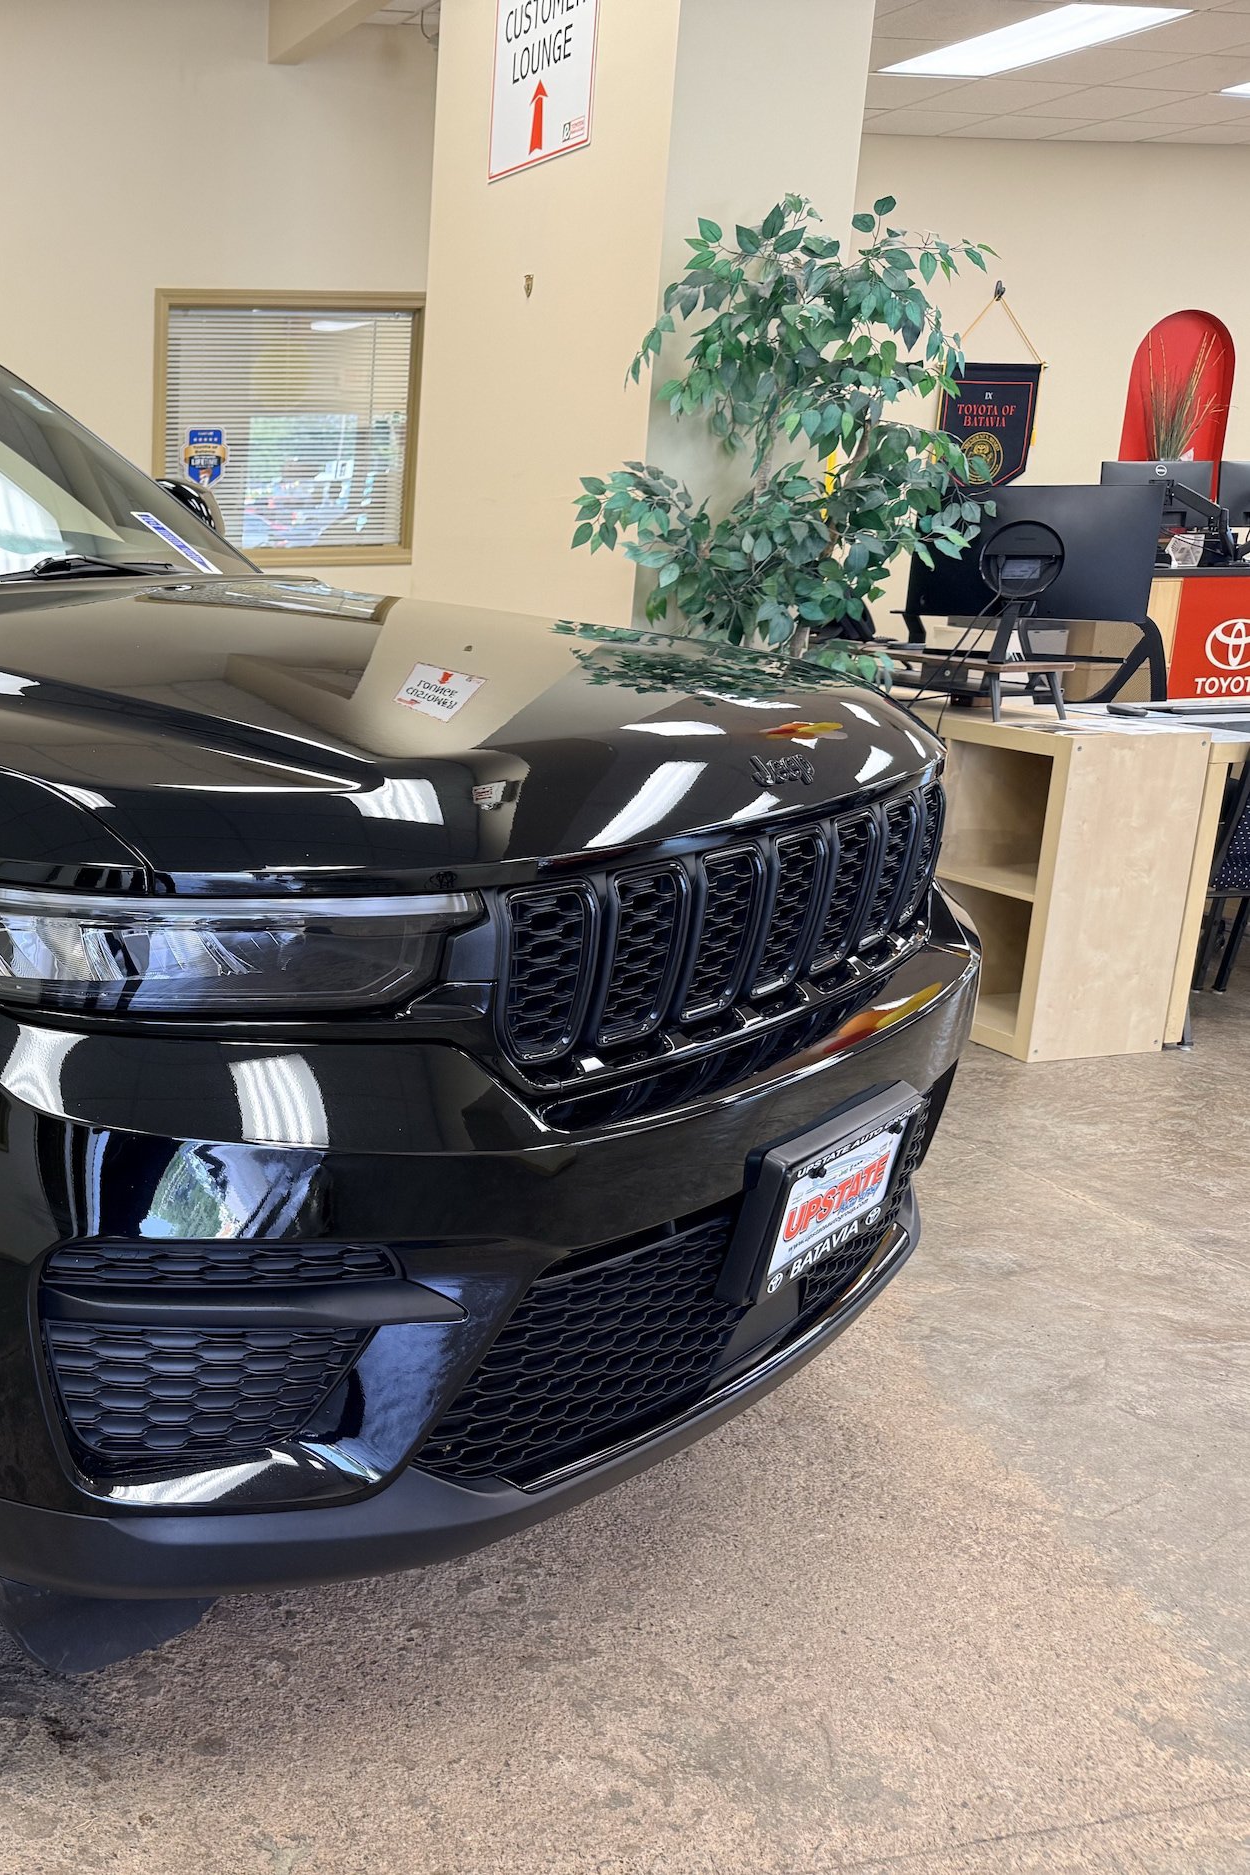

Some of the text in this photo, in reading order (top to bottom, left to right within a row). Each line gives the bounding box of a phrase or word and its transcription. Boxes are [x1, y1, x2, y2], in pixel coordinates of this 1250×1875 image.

[512, 23, 573, 85] LOUNGE
[957, 404, 1017, 416] TOYOTA OF
[963, 415, 1006, 428] BATAVIA
[748, 753, 815, 787] Jeep
[797, 1143, 851, 1178] UPSTATE
[851, 1127, 883, 1150] AUTO
[884, 1103, 922, 1129] GROUP
[783, 1151, 891, 1242] UPSTATE
[789, 1219, 859, 1279] BATAVIA
